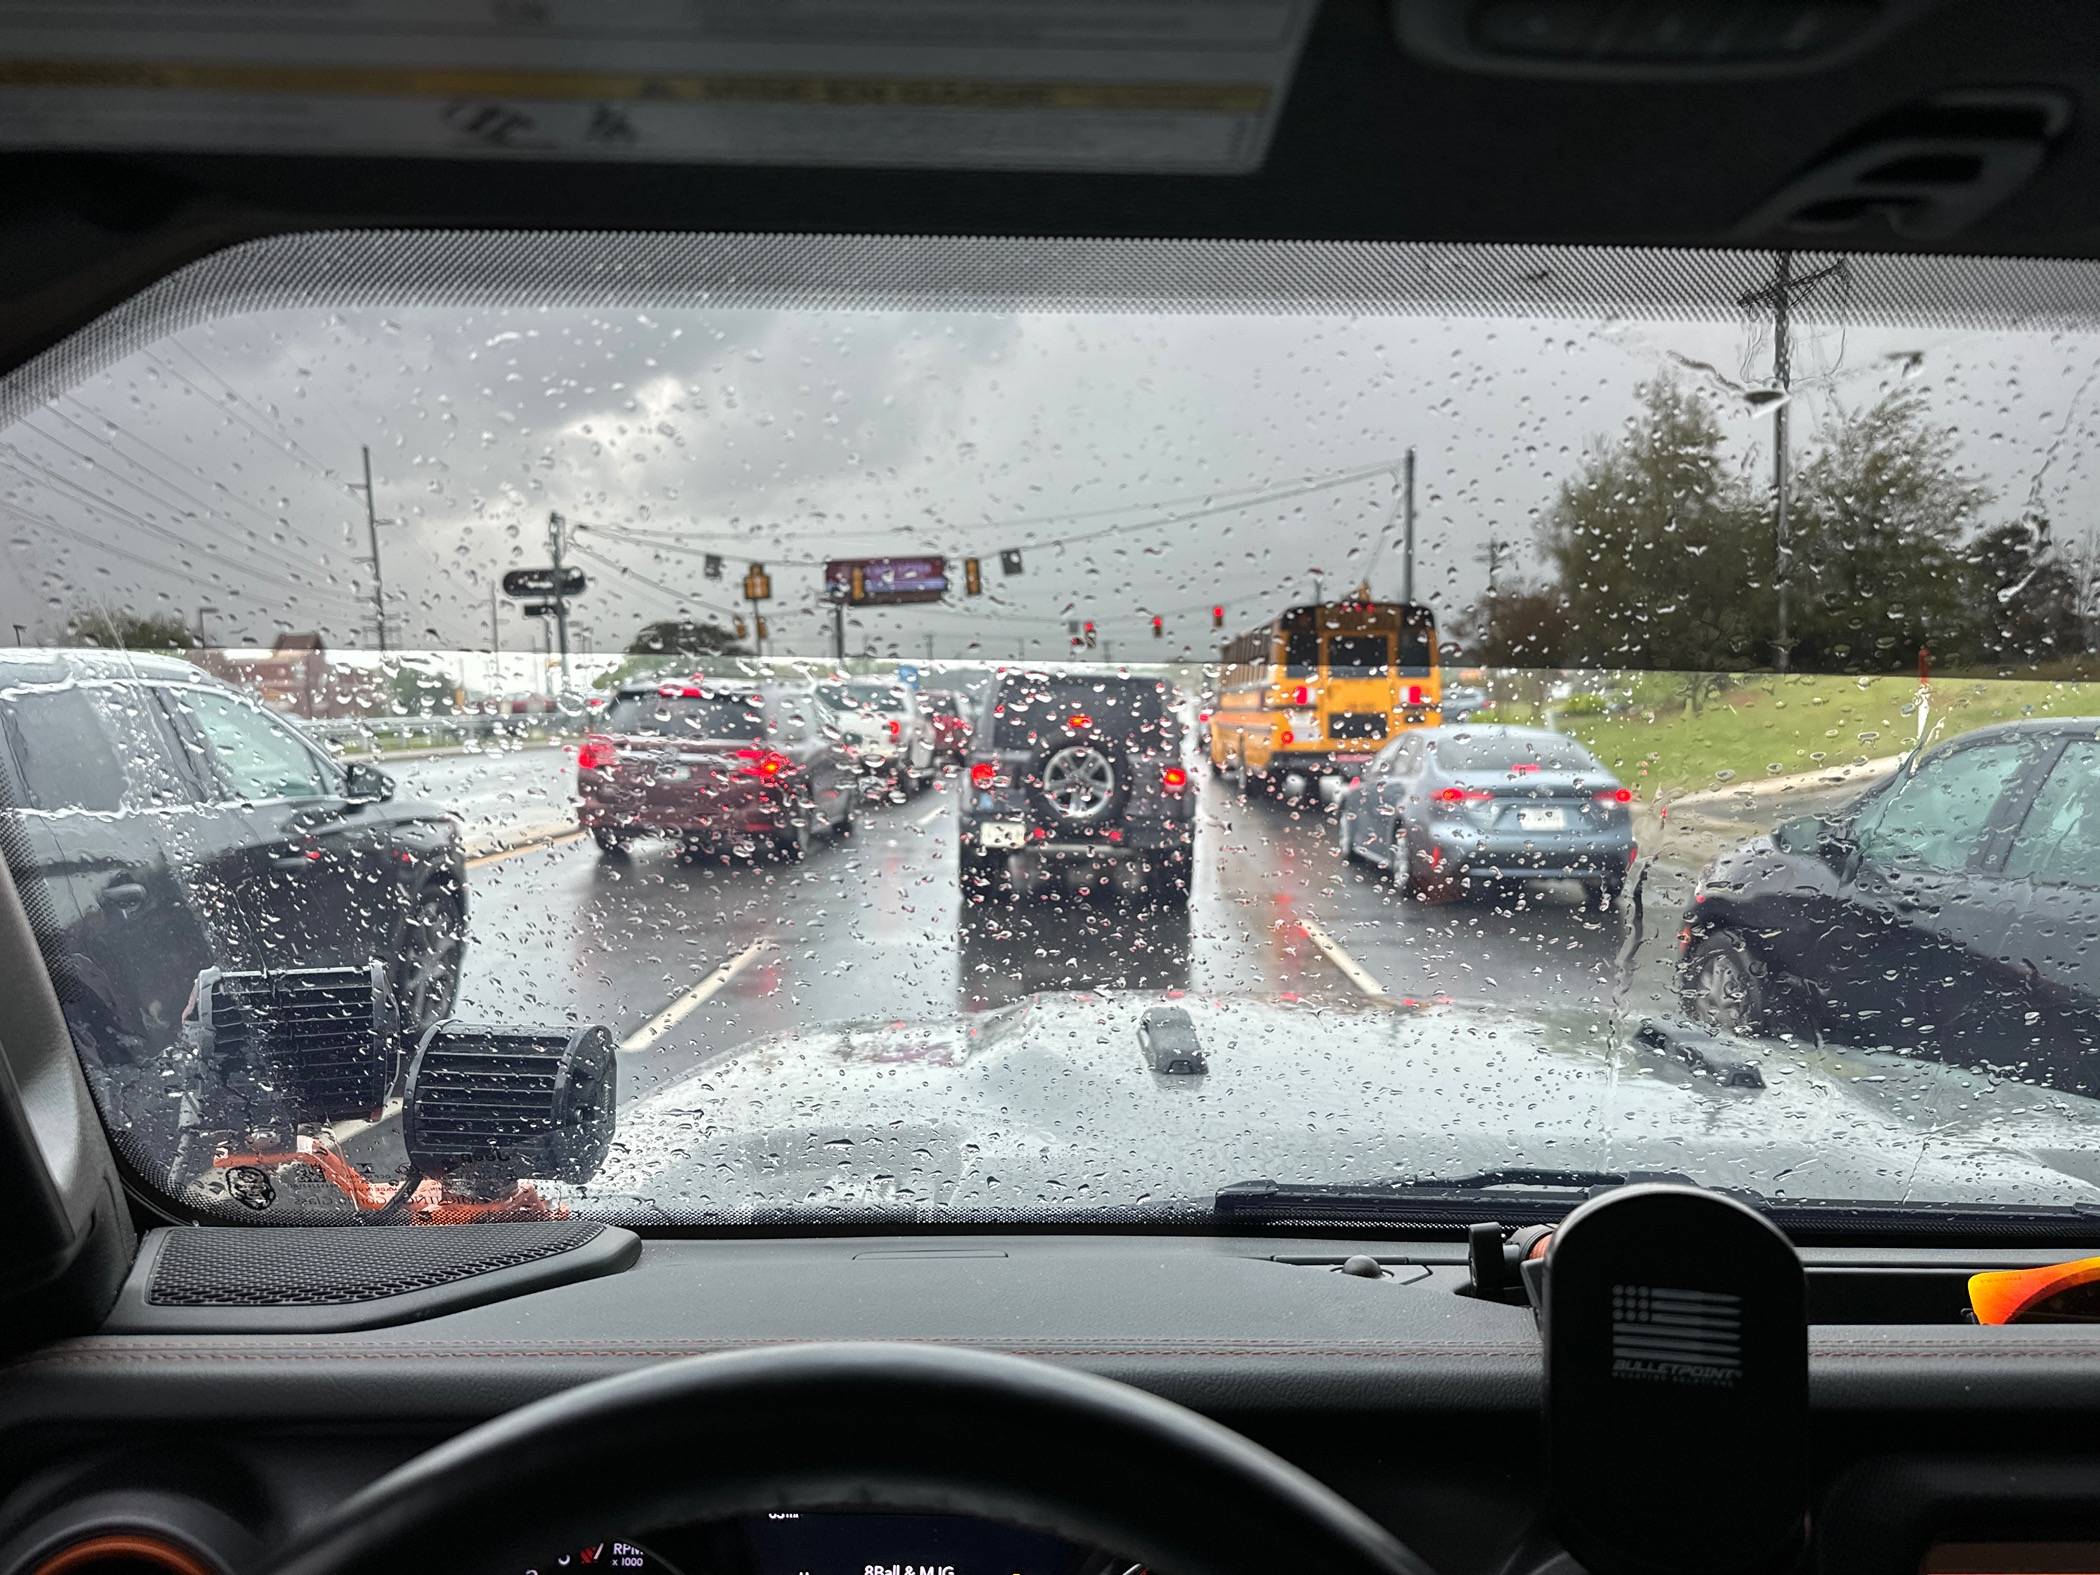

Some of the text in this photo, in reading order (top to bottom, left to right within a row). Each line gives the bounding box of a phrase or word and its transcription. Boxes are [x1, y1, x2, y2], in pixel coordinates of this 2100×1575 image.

[1612, 1358, 1736, 1379] BULLETPOINT
[622, 1557, 644, 1567] 1000
[864, 1564, 900, 1575] 8Ball
[904, 1565, 917, 1575] &
